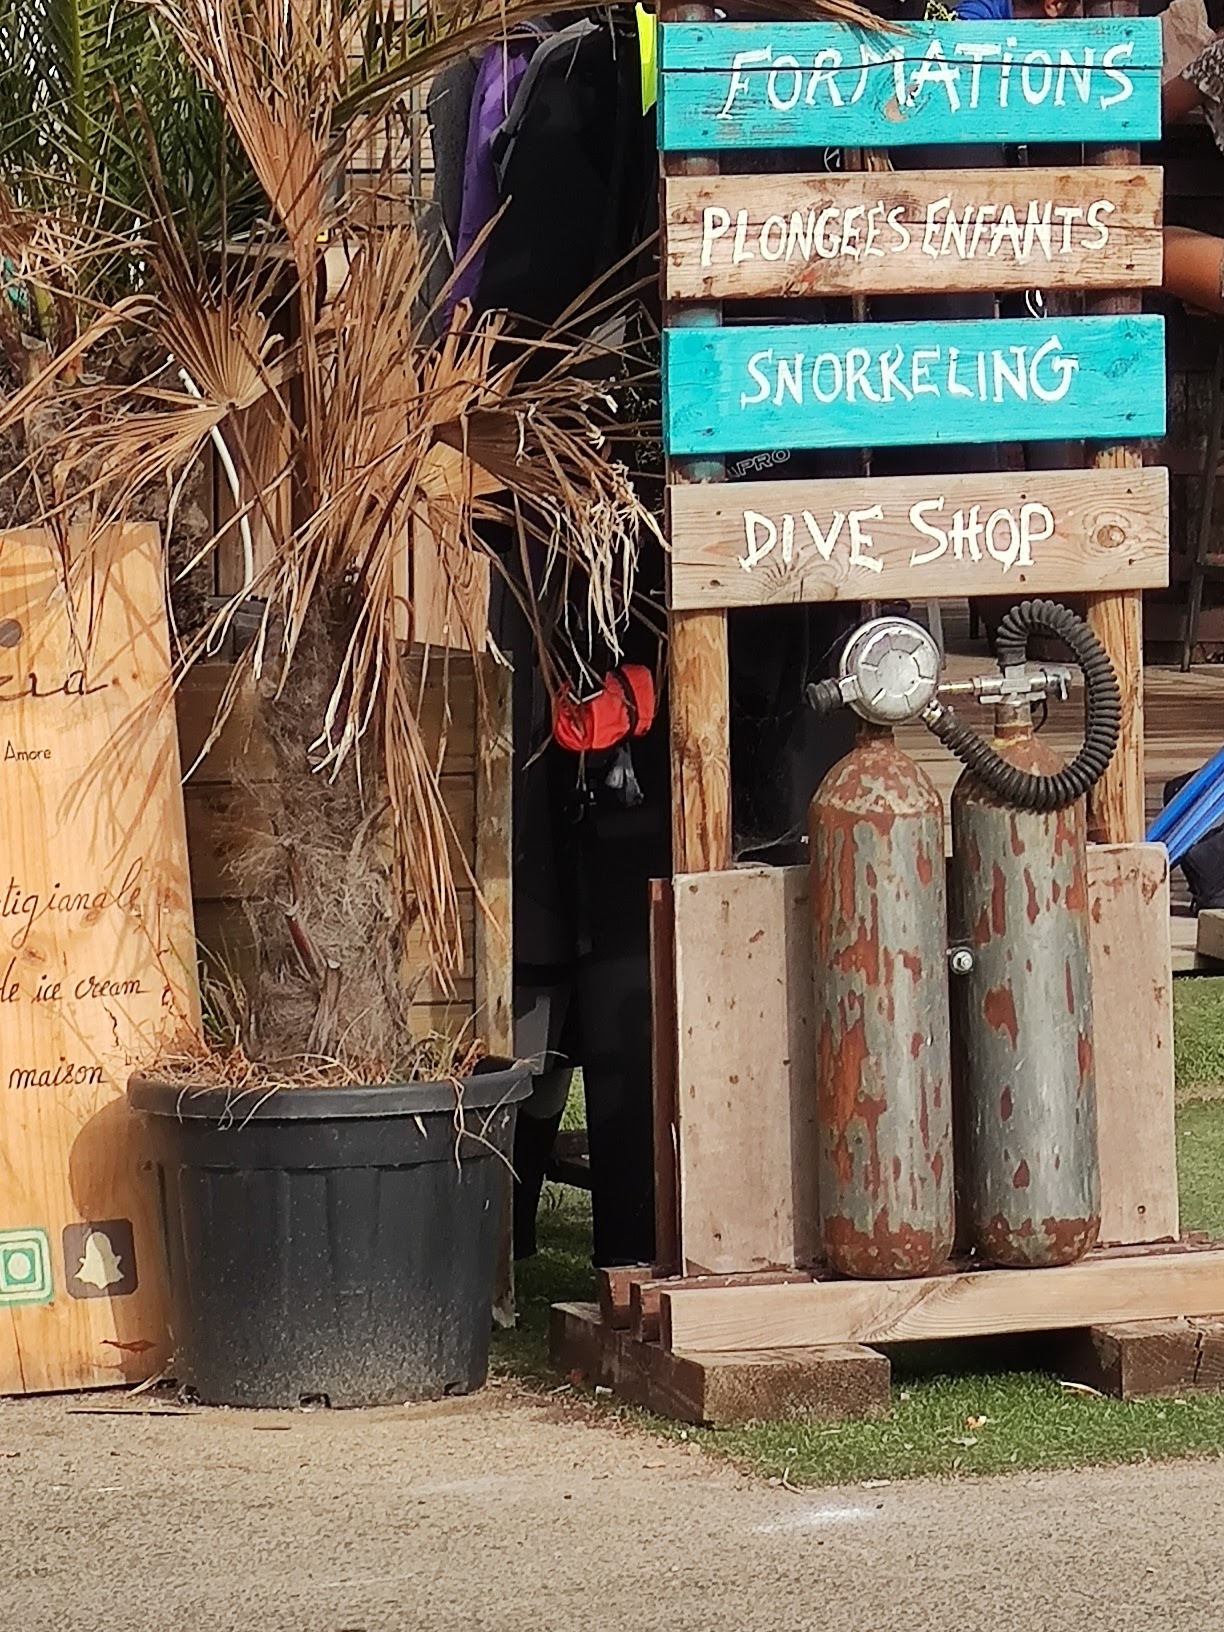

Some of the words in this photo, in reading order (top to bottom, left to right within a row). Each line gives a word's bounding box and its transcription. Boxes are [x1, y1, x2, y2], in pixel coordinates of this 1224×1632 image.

[920, 192, 1116, 265] ENFANTS
[740, 334, 1080, 410] SNORKELING
[737, 504, 886, 573] DIVE
[908, 496, 1056, 574] SHOP
[4, 739, 52, 762] Amore
[31, 974, 63, 1004] ice
[74, 975, 151, 999] cream
[8, 1056, 109, 1089] maison
